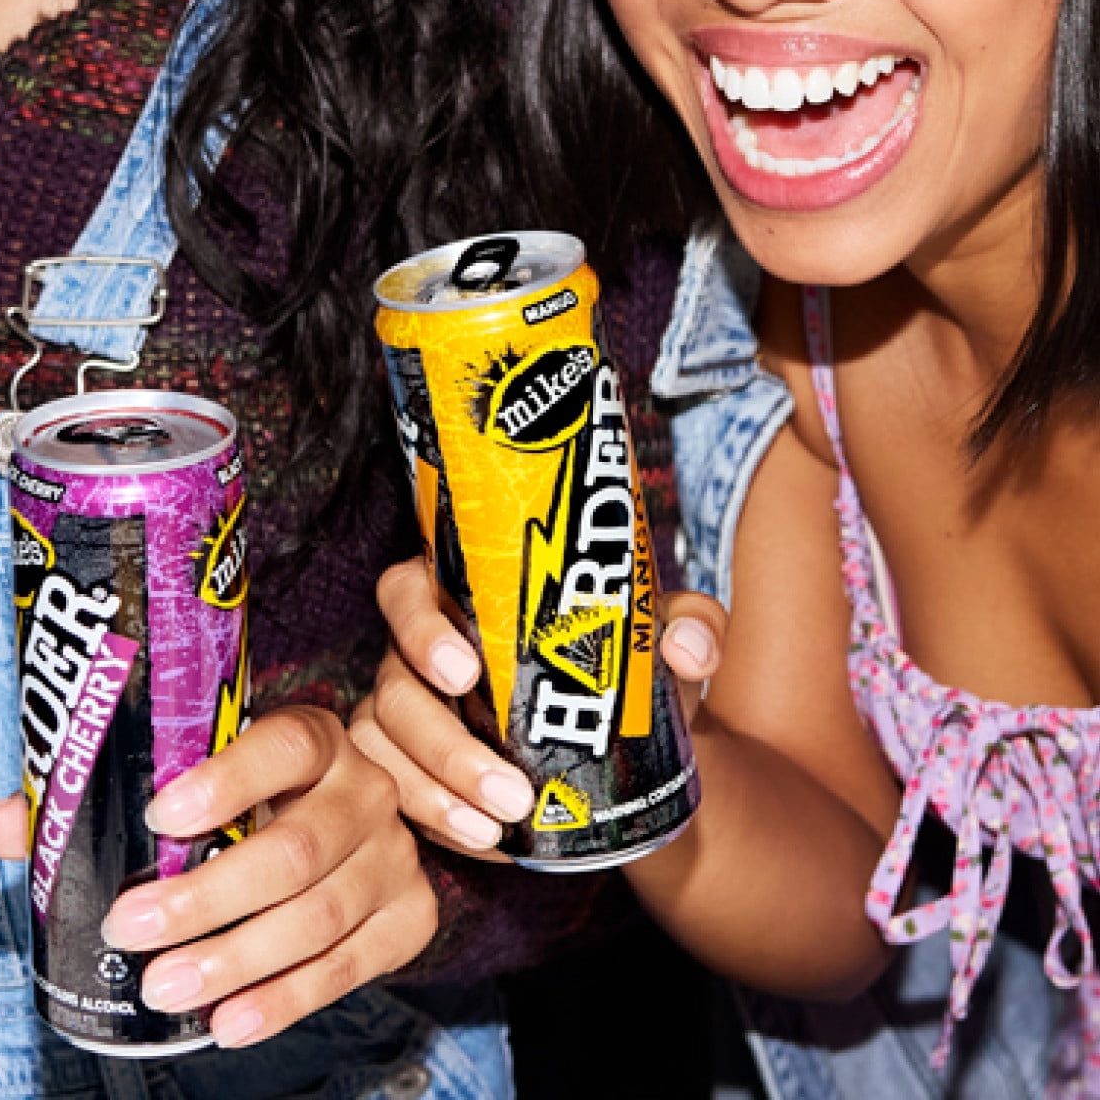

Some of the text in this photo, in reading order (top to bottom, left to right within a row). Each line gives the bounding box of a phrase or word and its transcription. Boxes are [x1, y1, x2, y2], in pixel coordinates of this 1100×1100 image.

[525, 290, 577, 322] MANGO
[496, 348, 594, 438] mike's
[528, 364, 635, 758] HARDER
[31, 643, 130, 915] BLACK CHERRY
[80, 996, 138, 1017] ALCOHOL
